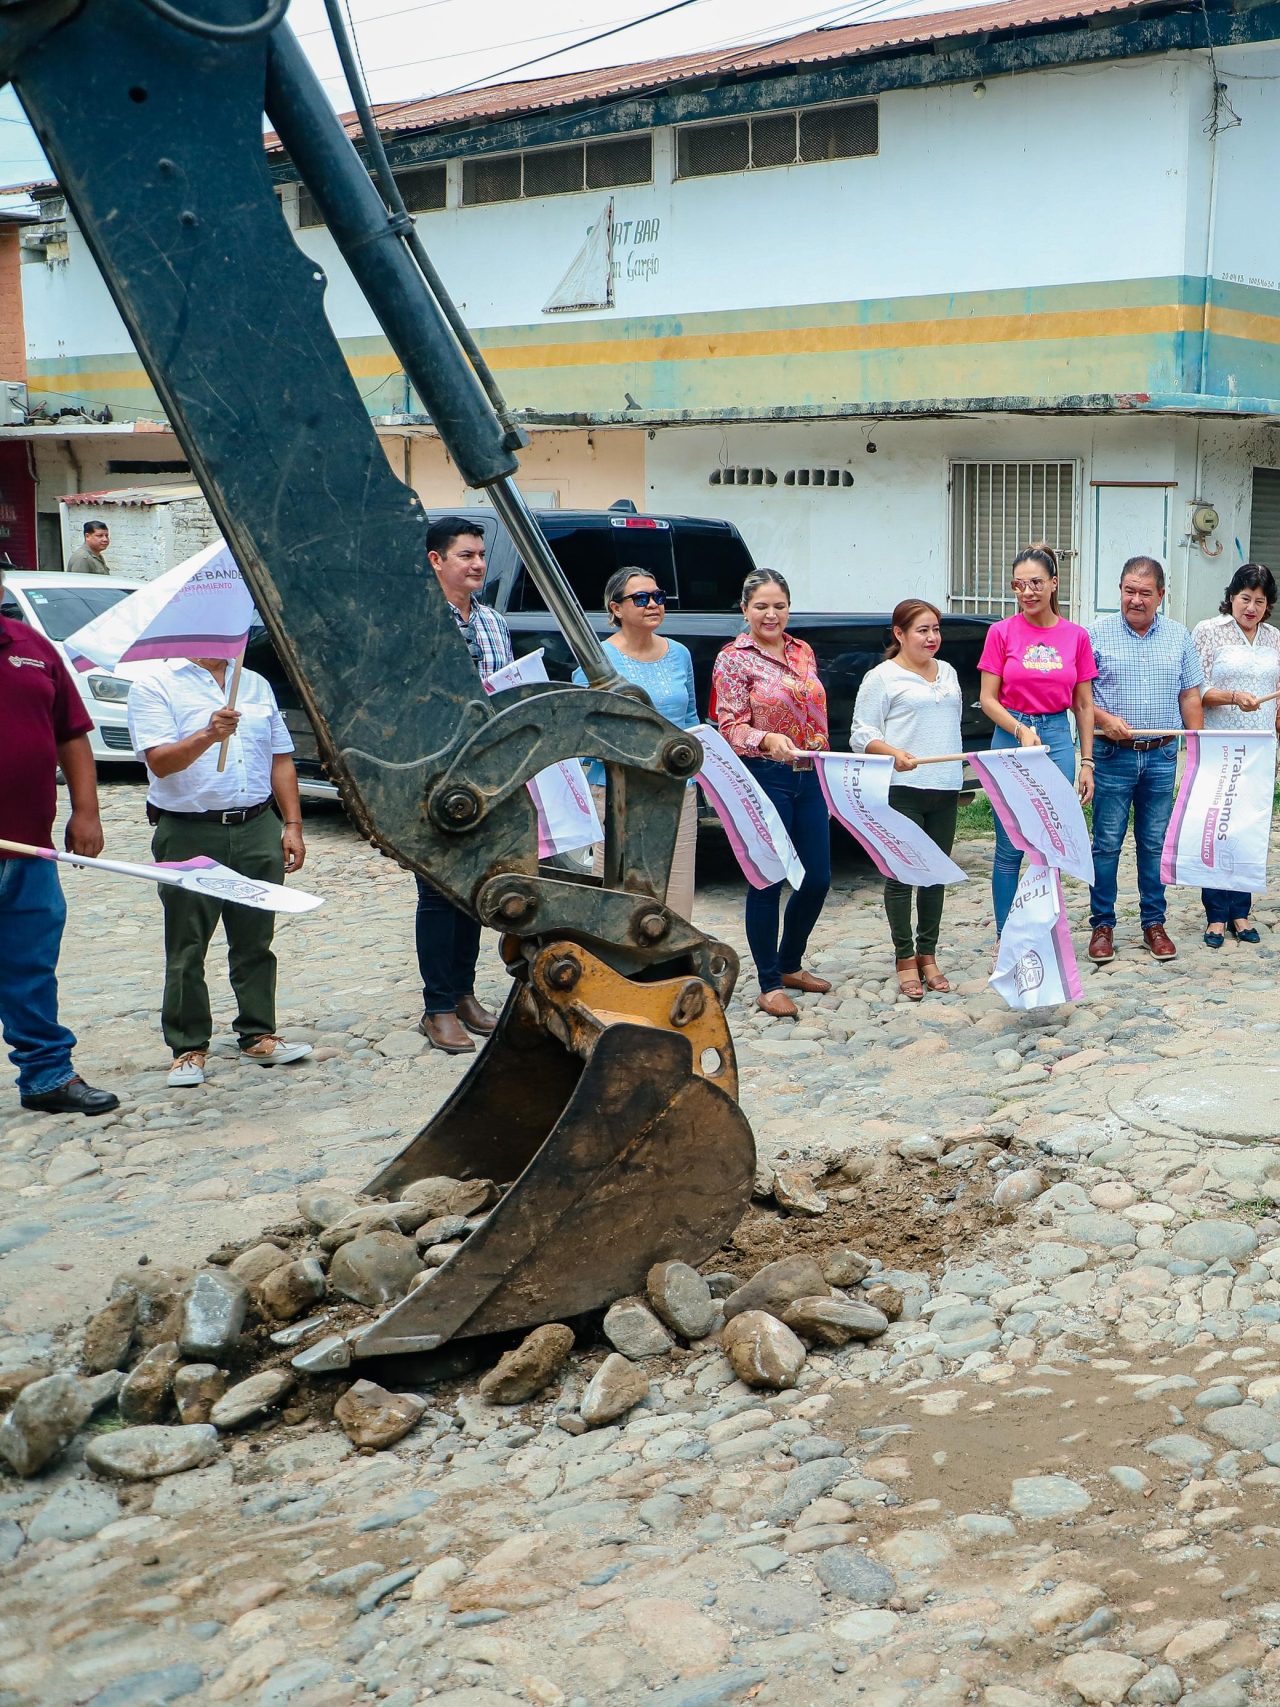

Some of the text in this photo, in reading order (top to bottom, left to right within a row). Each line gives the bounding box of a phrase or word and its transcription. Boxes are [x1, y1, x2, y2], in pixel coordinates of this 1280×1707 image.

[634, 218, 661, 244] BAR
[1212, 774, 1228, 806] familia
[1217, 744, 1246, 842] Trabajamos
[1043, 817, 1063, 848] futuro
[1202, 829, 1214, 860] futuro
